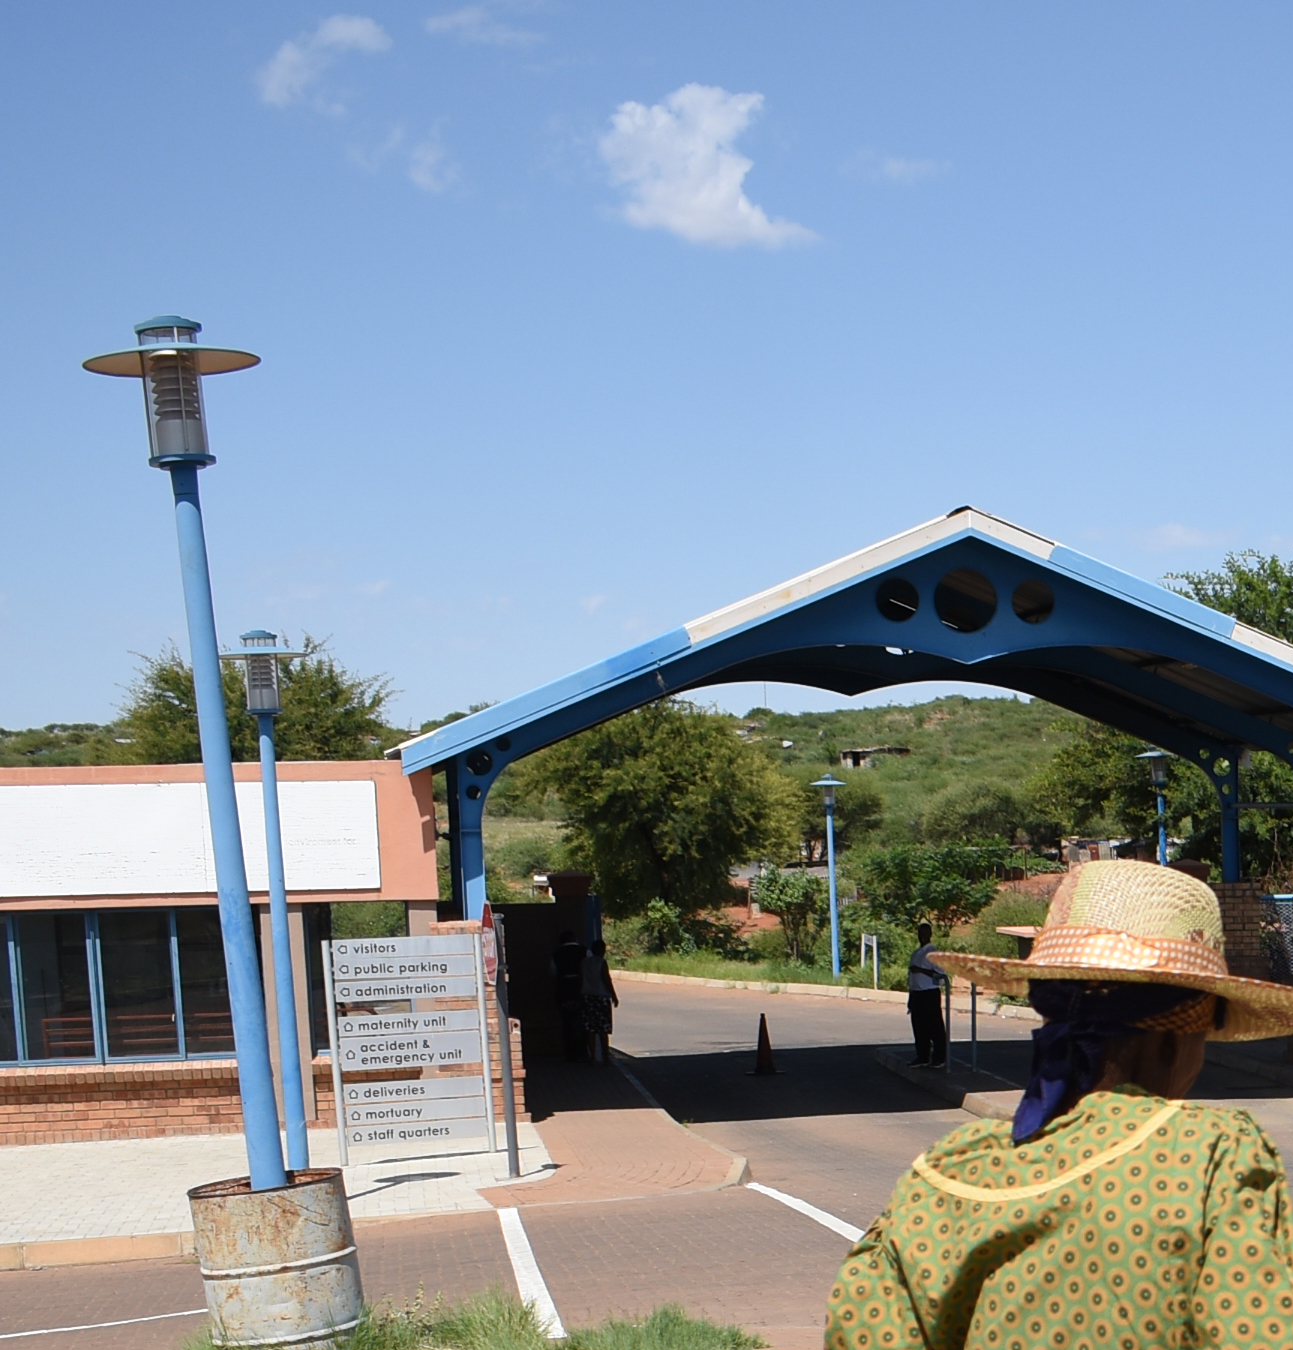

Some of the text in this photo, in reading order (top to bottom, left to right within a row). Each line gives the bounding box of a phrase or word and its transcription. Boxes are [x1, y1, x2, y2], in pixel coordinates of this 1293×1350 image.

[353, 944, 396, 954] visitors
[354, 962, 448, 976] public parking
[355, 983, 446, 997] administration
[358, 1016, 446, 1030] maternity unit
[360, 1039, 418, 1053] accident
[361, 1049, 462, 1065] emergency unit
[363, 1085, 426, 1098] deliveries
[365, 1108, 422, 1119] mortuary
[367, 1127, 450, 1140] staff quarters
